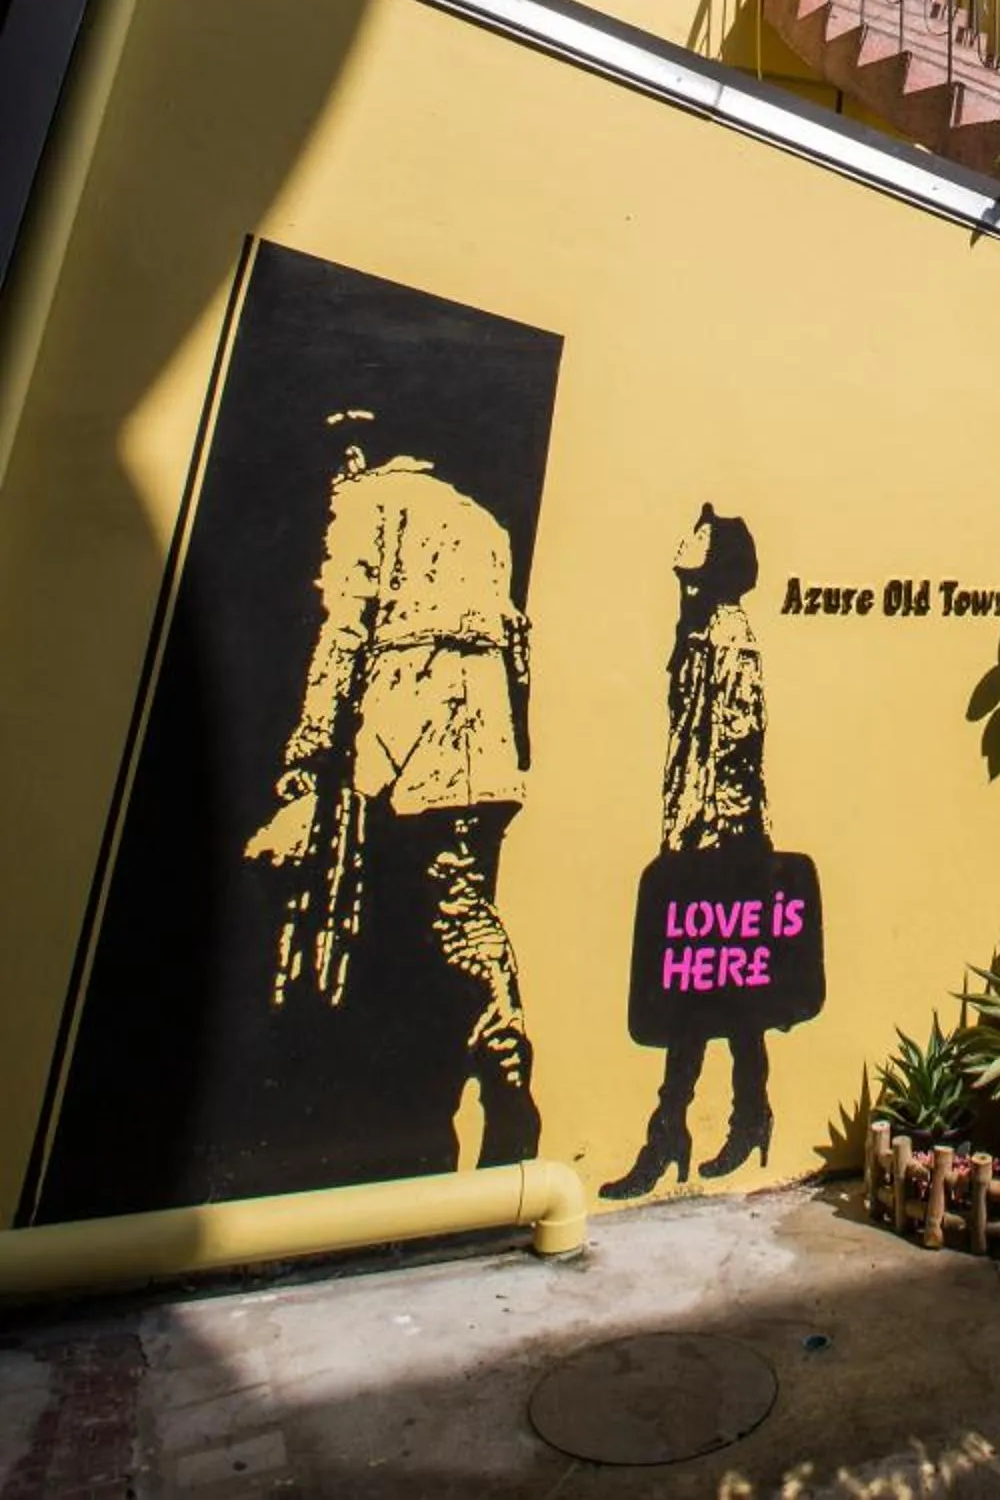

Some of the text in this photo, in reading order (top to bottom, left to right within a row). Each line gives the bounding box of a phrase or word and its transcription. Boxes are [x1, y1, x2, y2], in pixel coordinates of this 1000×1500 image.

[781, 577, 875, 615] Azure
[882, 579, 931, 617] Old
[666, 900, 763, 938] LOVE
